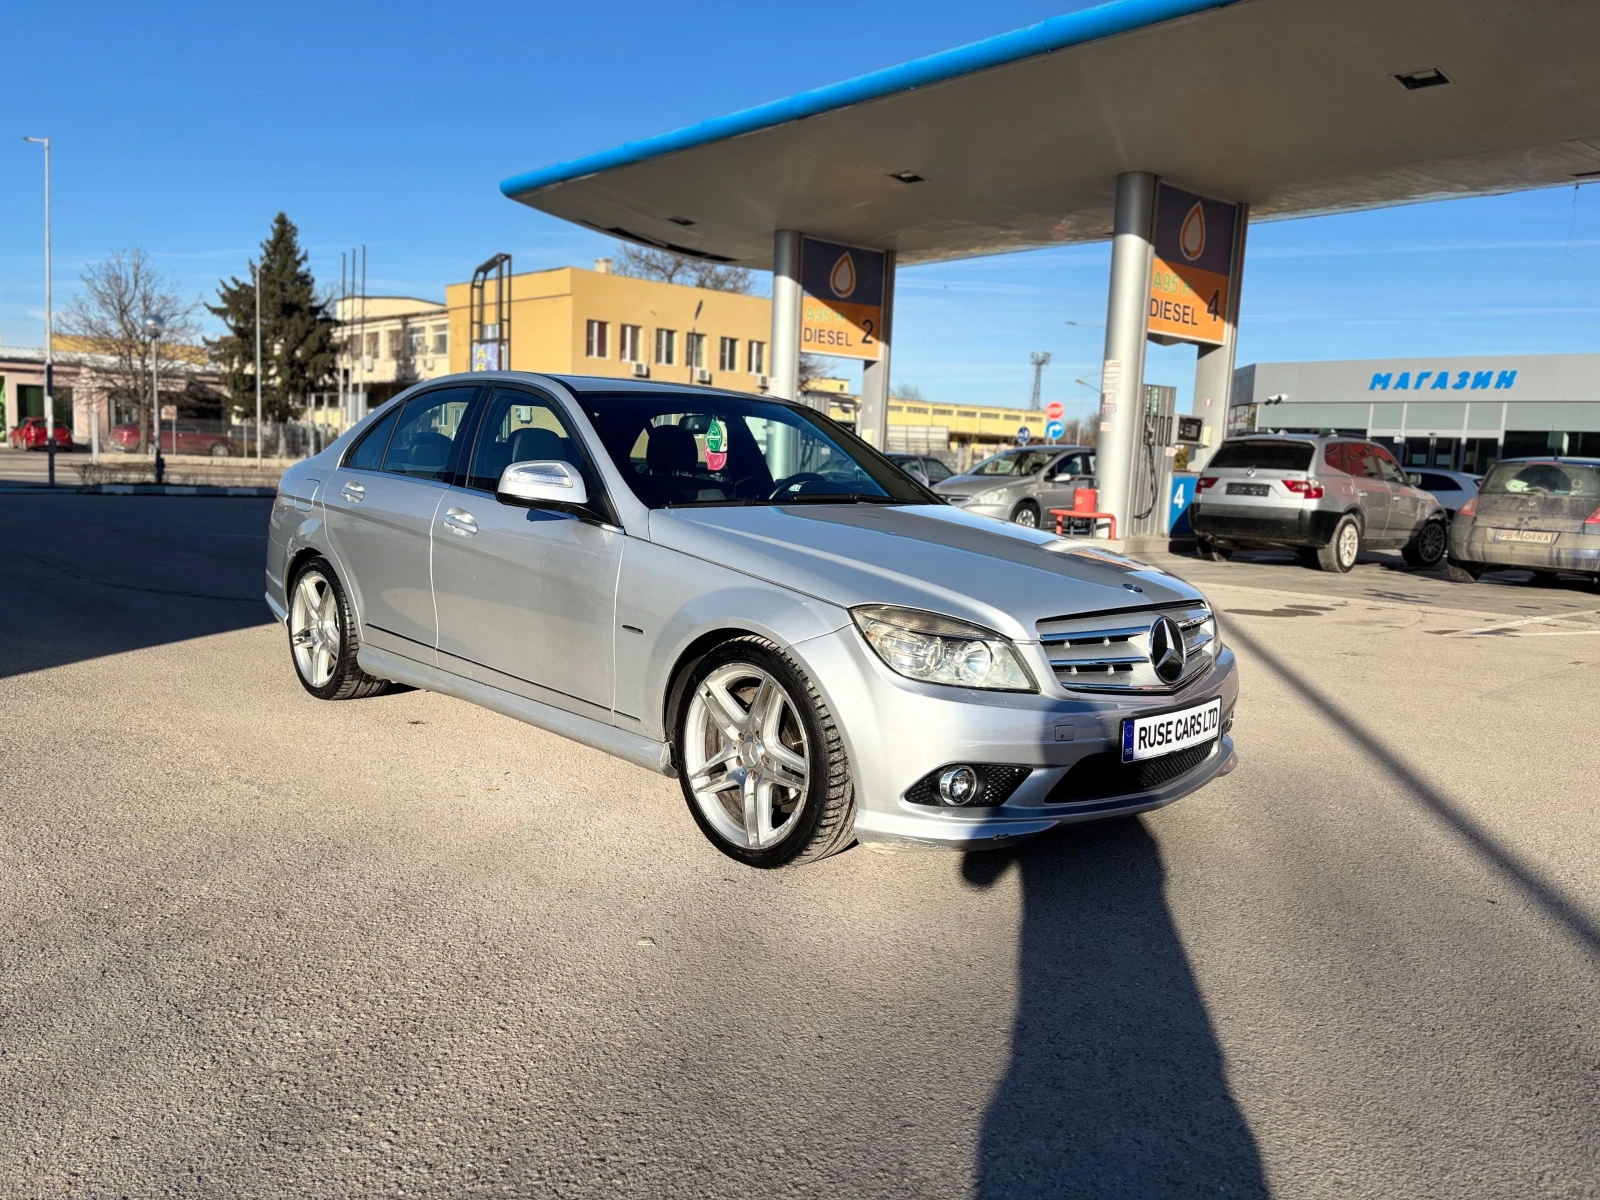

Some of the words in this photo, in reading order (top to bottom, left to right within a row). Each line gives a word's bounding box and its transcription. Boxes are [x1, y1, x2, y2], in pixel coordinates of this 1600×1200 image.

[1152, 270, 1179, 294] A95
[805, 306, 831, 323] A95
[1149, 298, 1199, 326] DIESEL
[1207, 289, 1220, 322] 4
[803, 327, 853, 347] DIESEL
[861, 319, 874, 345] 2
[1368, 369, 1518, 391] МАГАЗИН
[1173, 483, 1185, 509] 4
[1138, 720, 1174, 750] RUSE
[1175, 712, 1203, 741] CARS
[1203, 707, 1218, 732] LTD
[1124, 747, 1133, 755] BG
